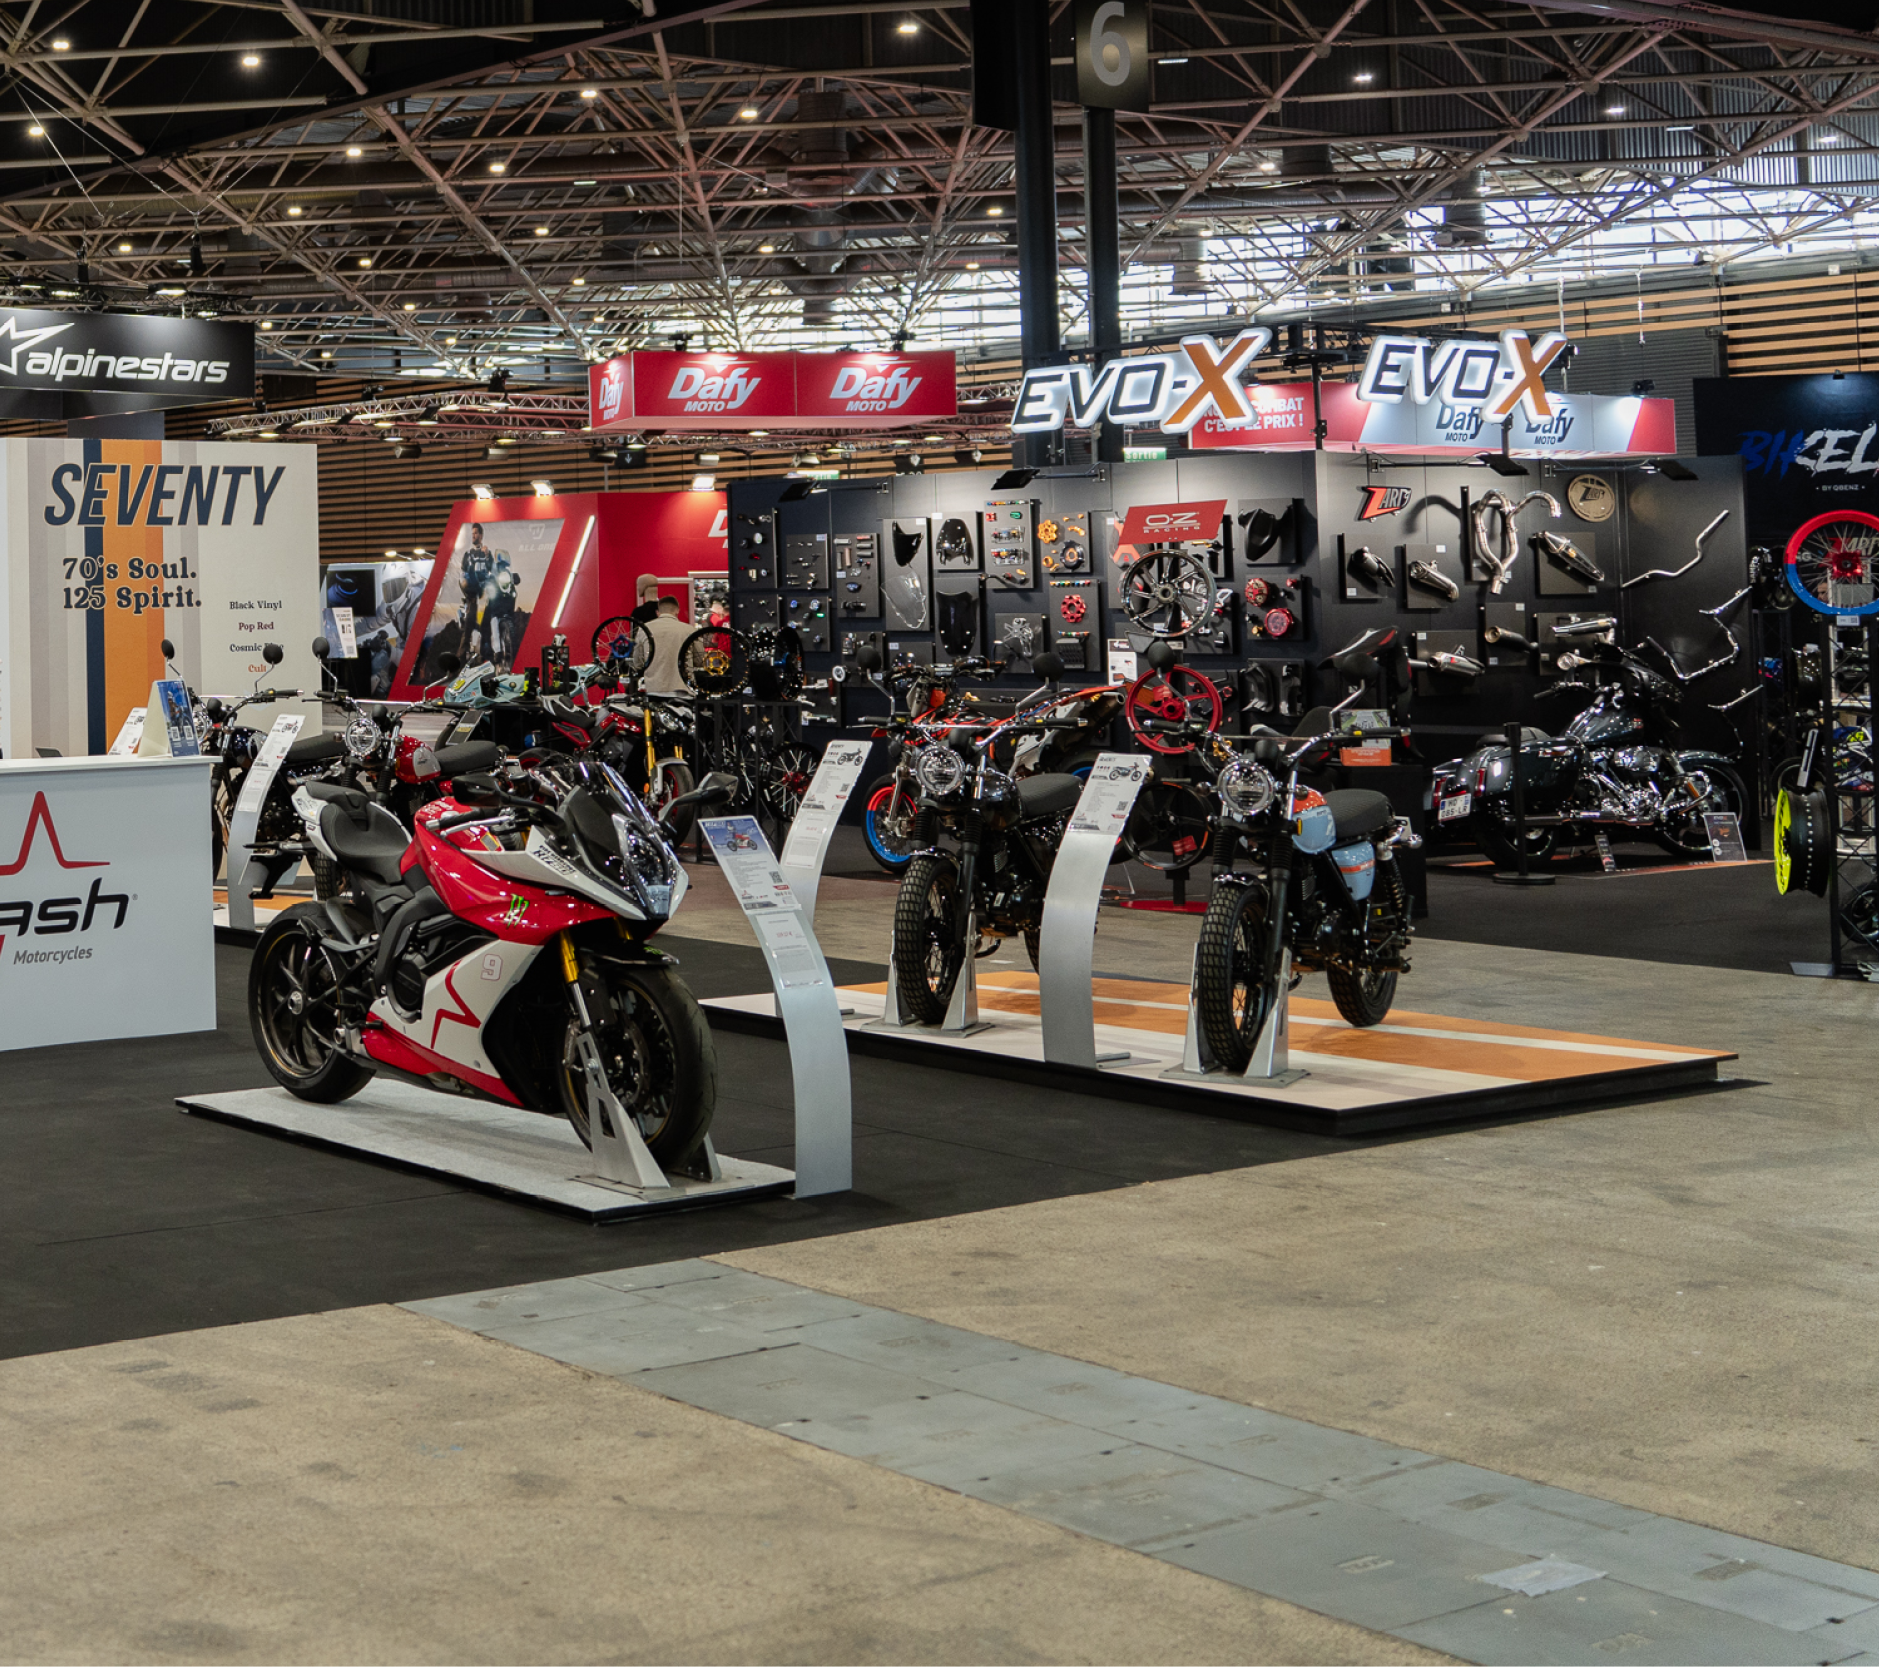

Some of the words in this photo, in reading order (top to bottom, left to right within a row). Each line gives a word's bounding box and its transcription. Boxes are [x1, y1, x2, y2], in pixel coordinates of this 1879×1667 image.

[1089, 1, 1131, 87] 6
[25, 347, 231, 383] alpinestars
[1369, 334, 1568, 418] EVO-X
[668, 367, 762, 409] Dafy
[830, 367, 922, 408] Dafy
[1014, 333, 1265, 428] EVO-X
[599, 375, 624, 414] Dafy
[683, 400, 725, 412] MOTO
[845, 400, 887, 412] MOTO
[1264, 414, 1296, 429] PRIX
[1445, 433, 1469, 442] MOTO
[1534, 435, 1557, 445] MOTO
[1126, 451, 1157, 460] Sortie
[43, 463, 286, 526] SEVENTY
[62, 556, 119, 581] 70's
[128, 556, 198, 580] Soul.
[63, 585, 107, 610] 125
[116, 585, 203, 615] Spirit.
[229, 600, 254, 610] Black
[257, 600, 282, 612] Vinyl
[238, 621, 255, 632] Pop
[257, 621, 274, 631] Red
[229, 643, 262, 653] Cosmic
[248, 663, 267, 673] Cult
[13, 945, 93, 965] Motorcycles
[480, 954, 503, 980] 9
